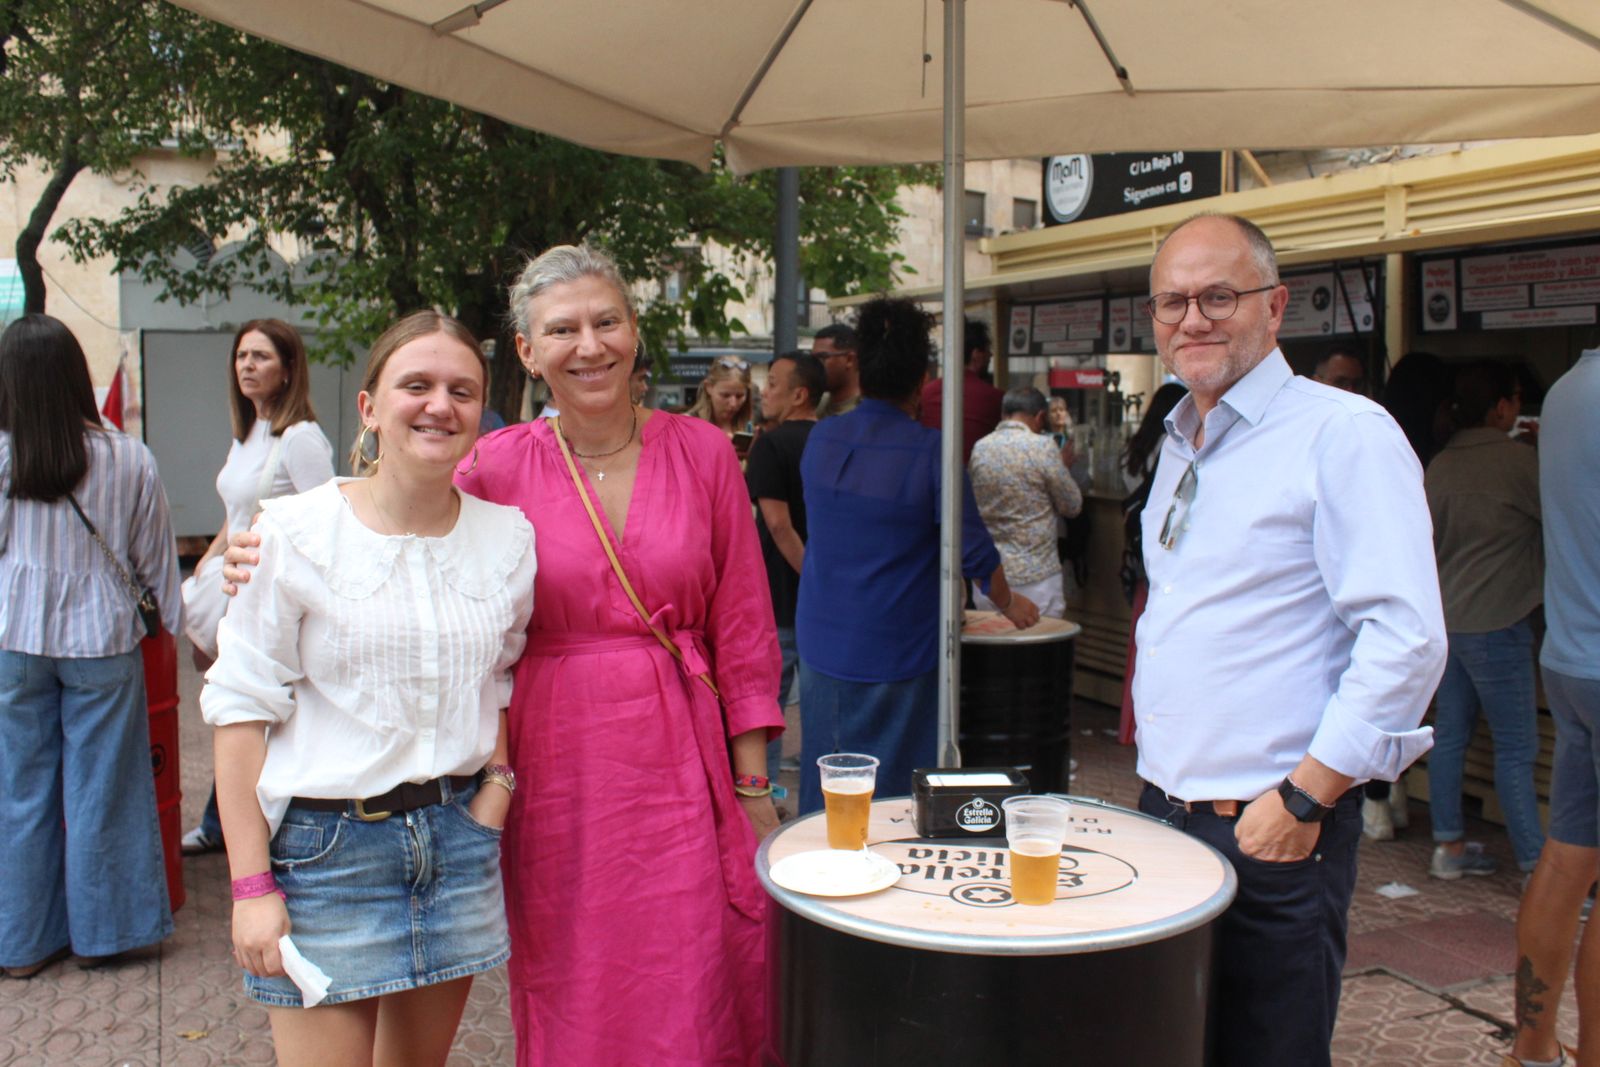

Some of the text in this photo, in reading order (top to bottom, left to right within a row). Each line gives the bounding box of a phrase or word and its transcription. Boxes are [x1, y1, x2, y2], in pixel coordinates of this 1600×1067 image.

[1140, 158, 1151, 173] La
[1173, 151, 1184, 164] 10
[963, 808, 993, 817] Estrella
[963, 816, 993, 825] Galicia
